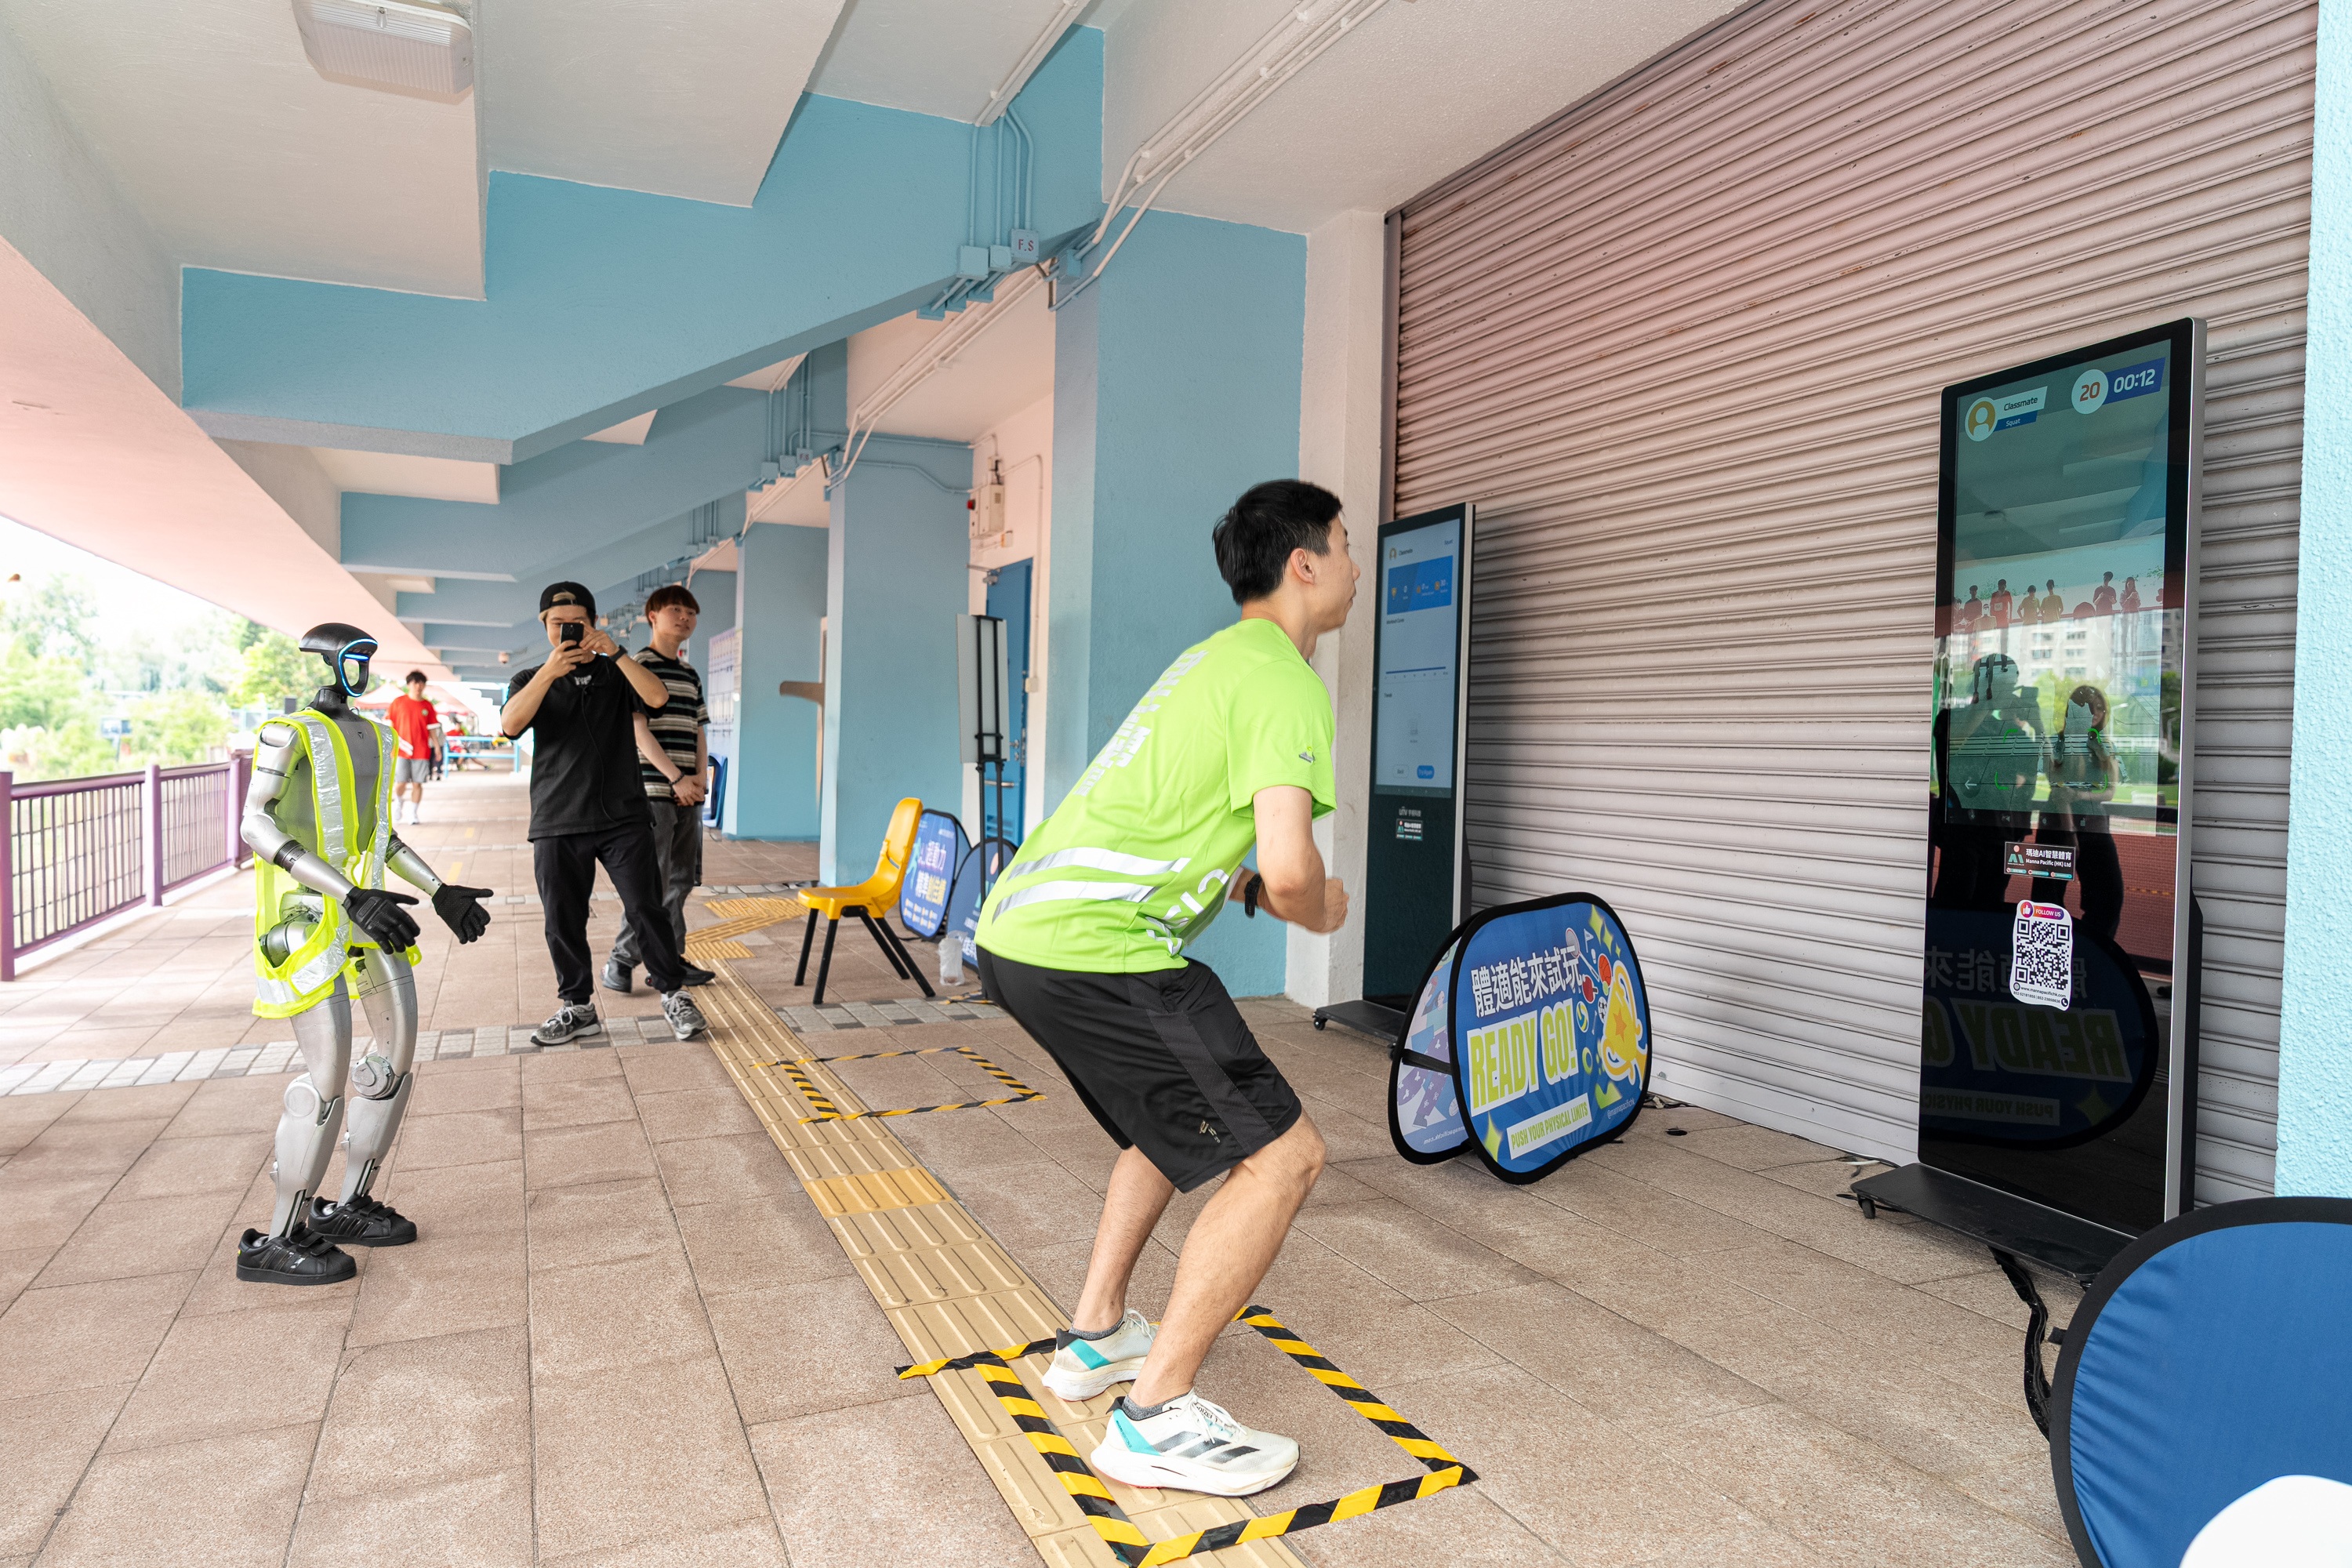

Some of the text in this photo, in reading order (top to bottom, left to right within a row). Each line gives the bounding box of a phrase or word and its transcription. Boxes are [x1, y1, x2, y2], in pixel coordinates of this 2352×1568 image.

[1018, 238, 1034, 252] F.S
[2079, 368, 2156, 402] 20 00:12
[2003, 396, 2038, 412] Classmate
[2005, 418, 2021, 428] Squat
[1470, 945, 1583, 1018] 體適能來試玩
[1469, 1004, 1577, 1110] READY GO!
[1511, 1102, 1588, 1150] PUSH YOUR PHYSICAL LIMITS
